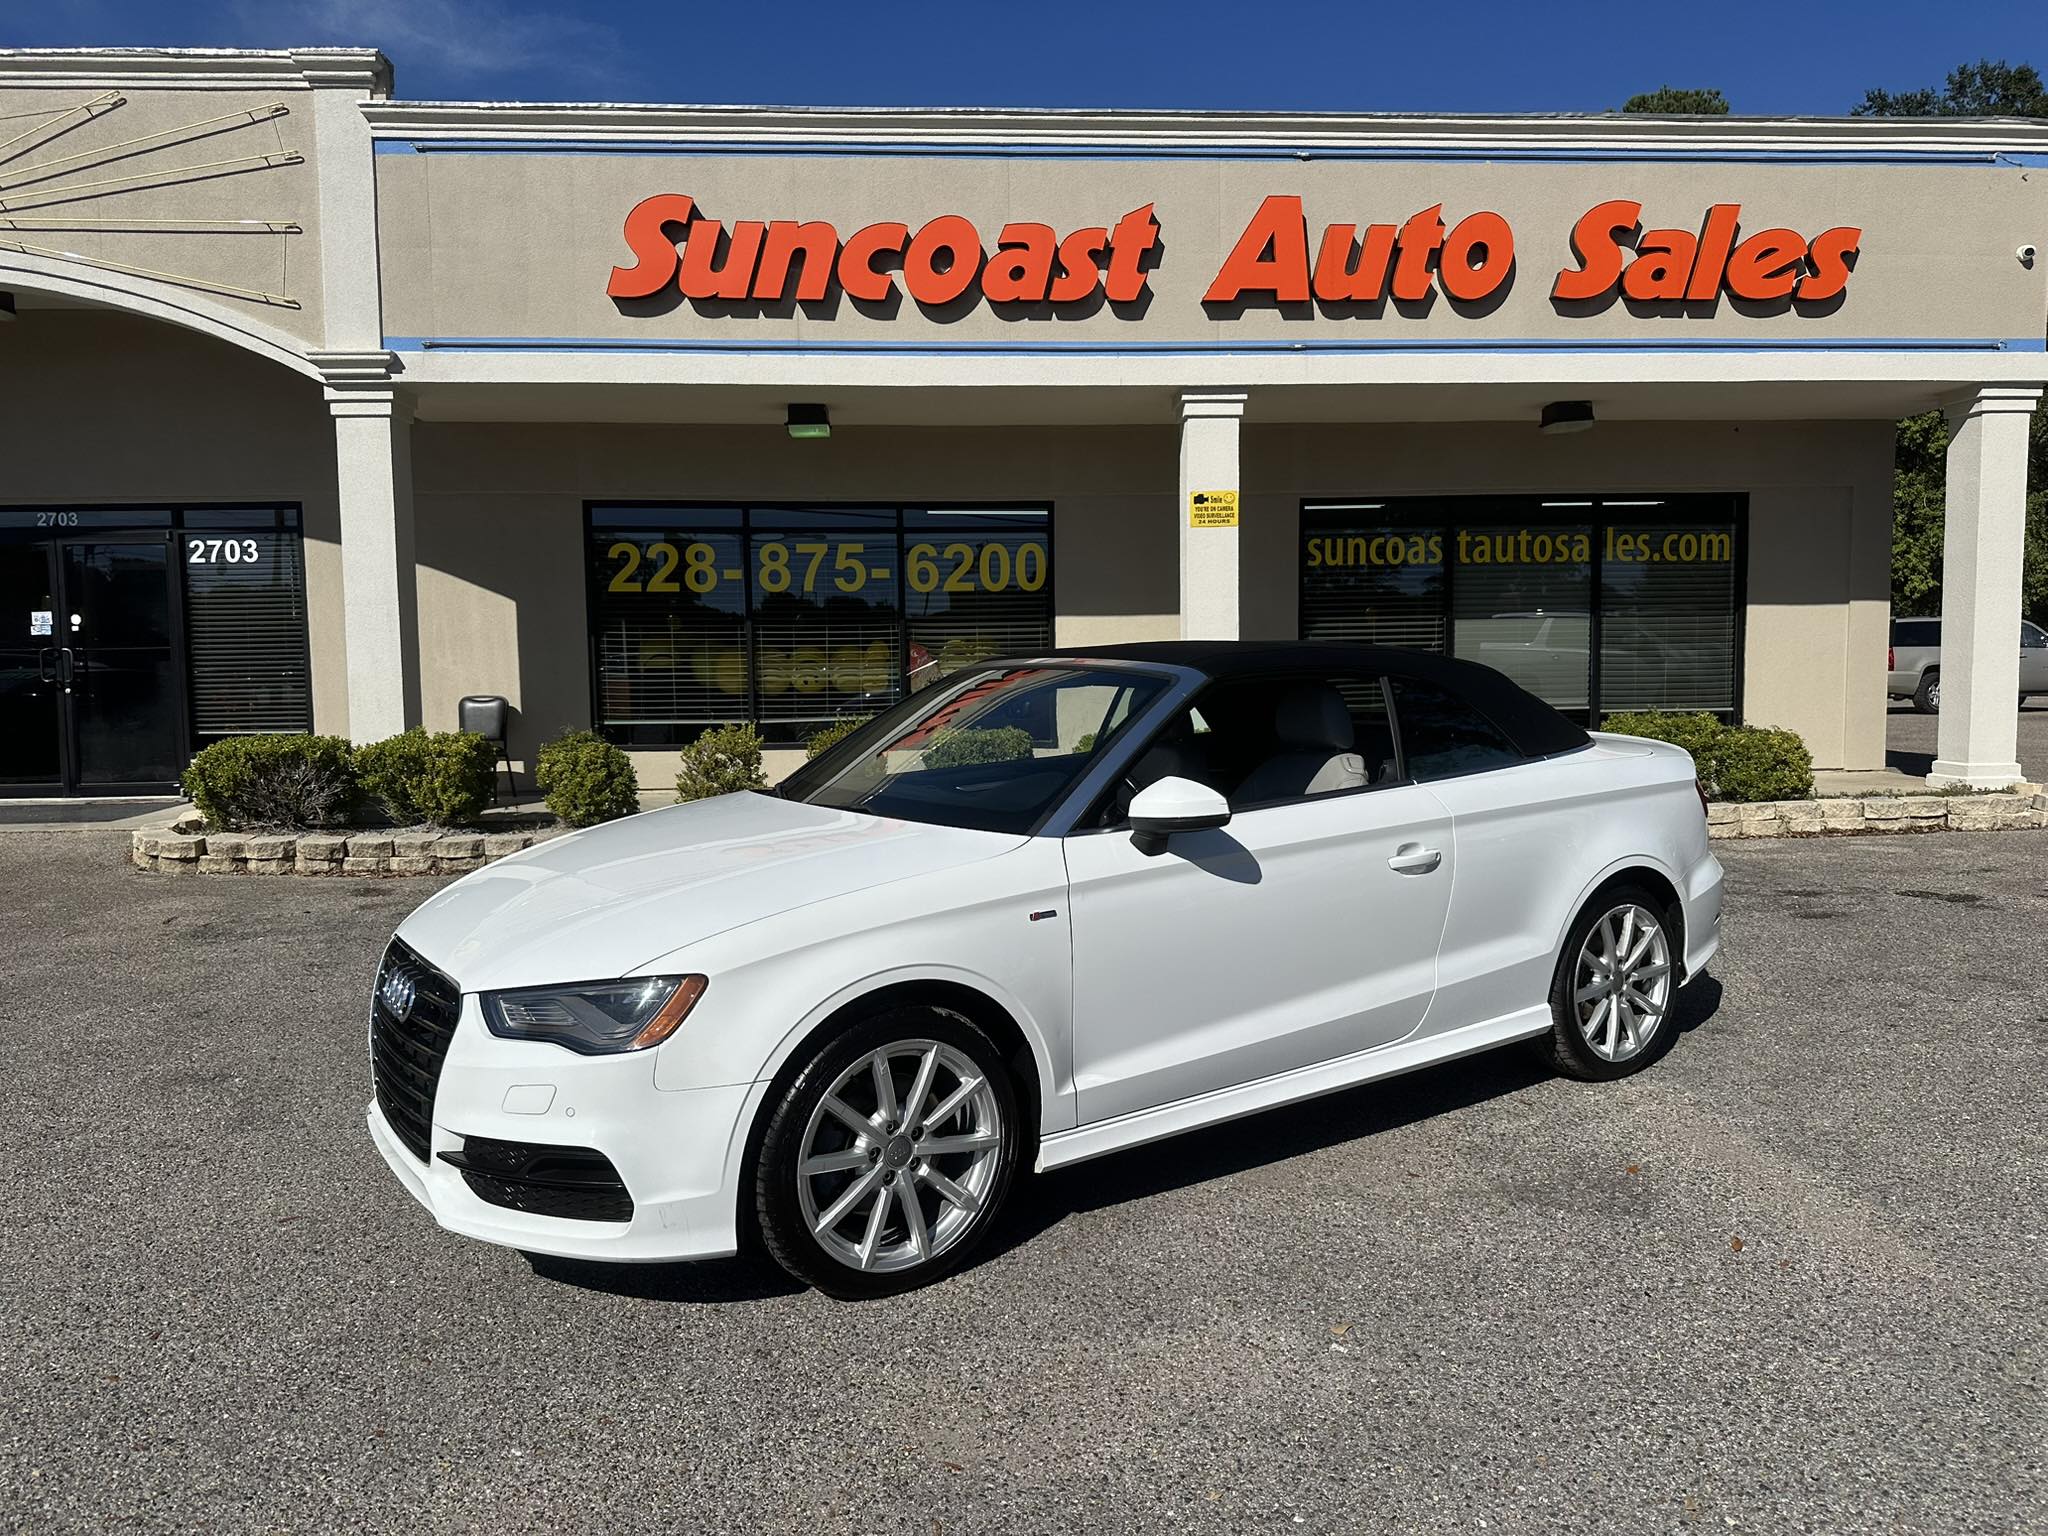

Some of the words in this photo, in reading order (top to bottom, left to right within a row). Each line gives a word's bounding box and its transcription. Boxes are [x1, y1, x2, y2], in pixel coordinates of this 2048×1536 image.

[606, 193, 1160, 305] Suncoast
[1202, 195, 1515, 302] Auto
[1553, 199, 1863, 302] Sales
[36, 511, 79, 527] 2703
[188, 539, 260, 565] 2703
[906, 542, 1047, 593] 6200
